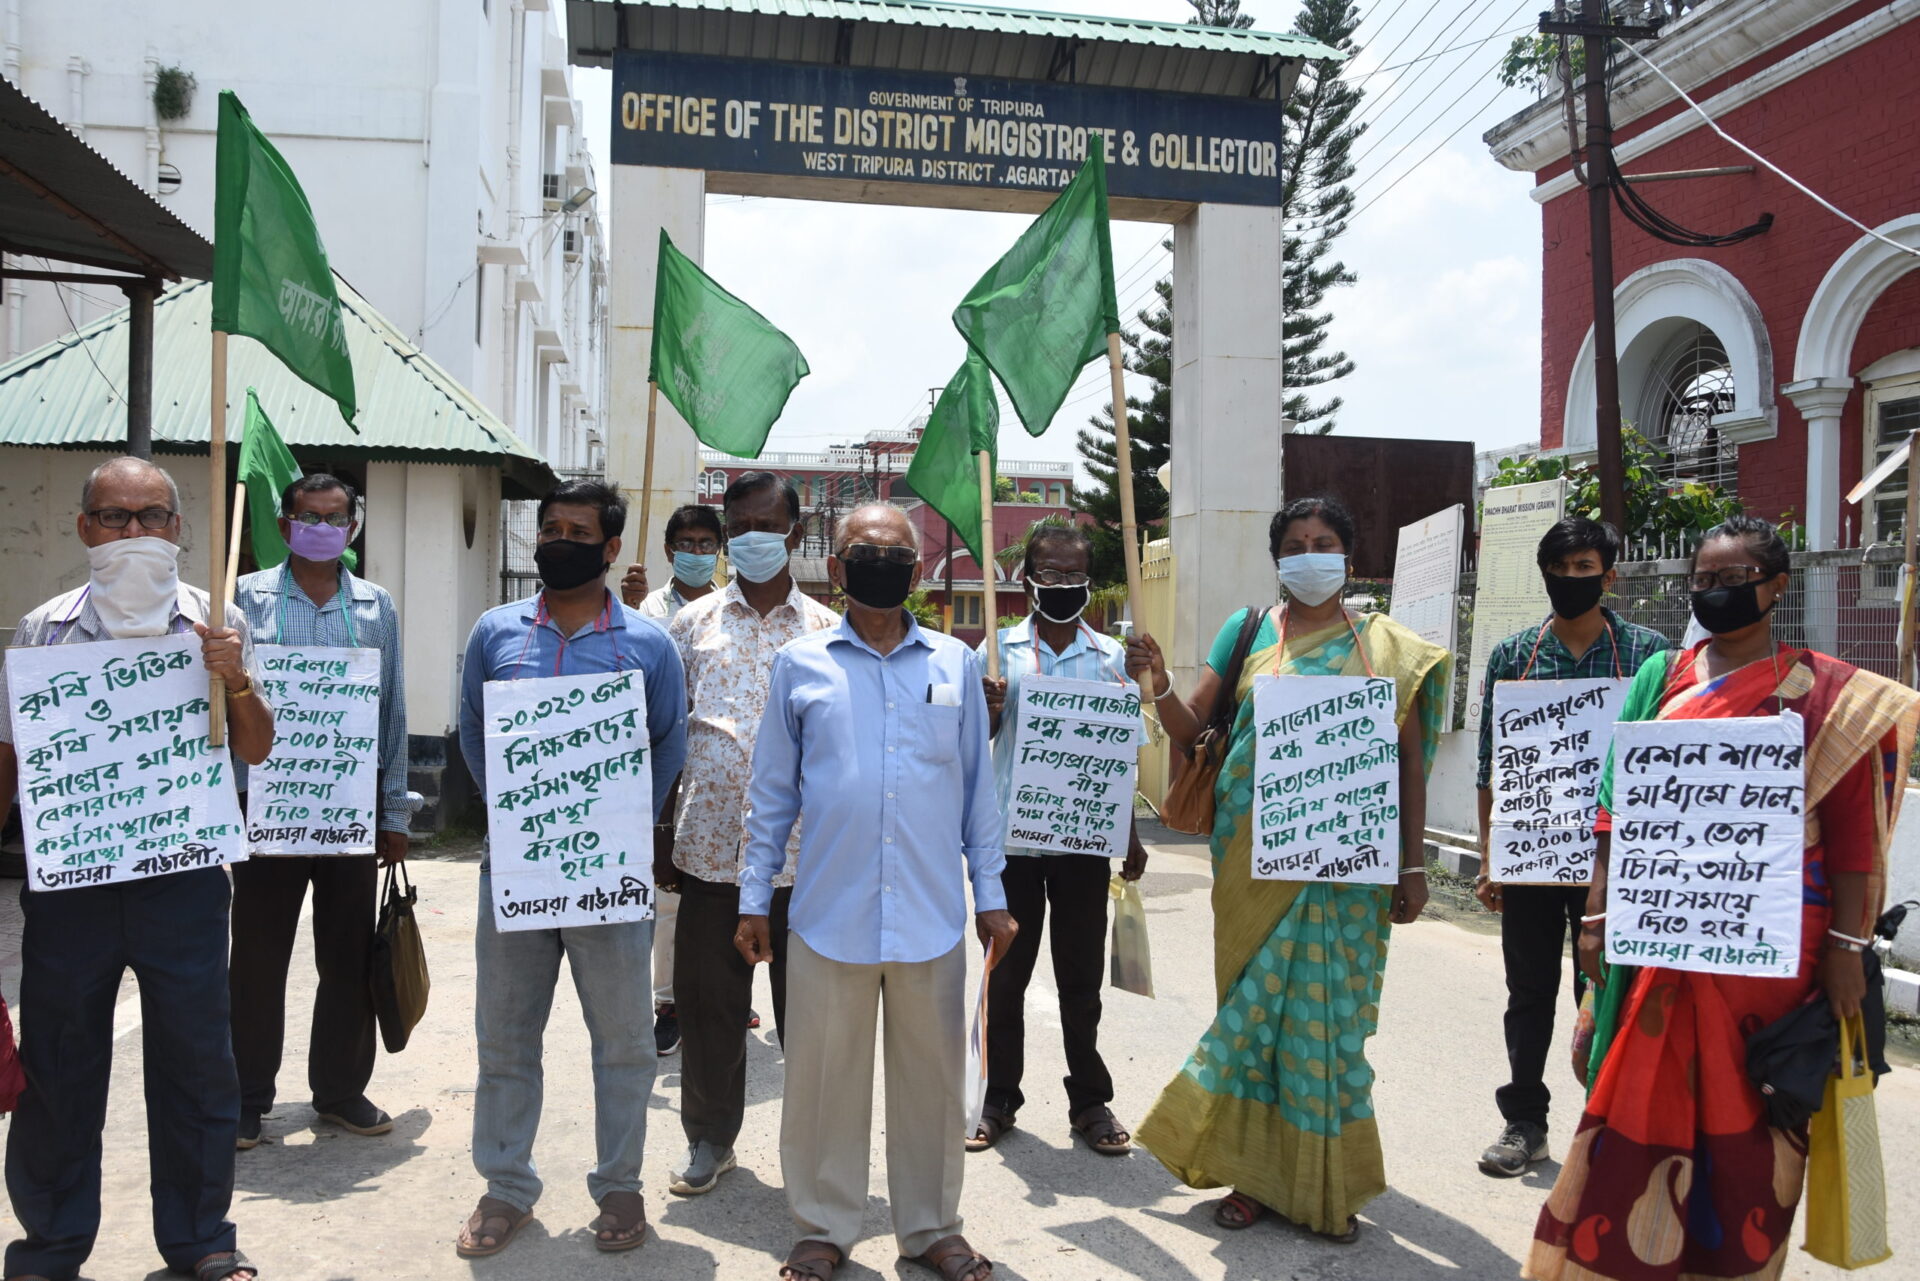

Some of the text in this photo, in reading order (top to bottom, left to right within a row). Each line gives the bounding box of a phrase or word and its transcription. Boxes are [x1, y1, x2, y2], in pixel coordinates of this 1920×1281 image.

[869, 91, 1044, 118] GOVERNMENT OF TRIPURA
[622, 91, 717, 137] OFFICE
[724, 100, 761, 139] OF
[769, 102, 823, 144] THE
[834, 106, 955, 152] DISTRICT
[1122, 130, 1140, 167] &
[1150, 132, 1277, 177] COLLECTOR
[803, 151, 847, 172] WEST
[852, 154, 915, 177] TRIPURA
[921, 158, 994, 184] DISTRICT
[19, 671, 91, 722] কৃষি
[85, 699, 112, 722] ও
[274, 702, 348, 727] তিমাসে
[1027, 715, 1135, 745] বন্ধ করতে
[25, 728, 96, 772] কৃষি
[333, 728, 376, 753] টাকা
[1269, 715, 1376, 761] বন্ধ করতে
[1498, 730, 1592, 770] বীজ সার
[1624, 742, 1803, 774] রেশন শপের
[36, 785, 148, 830] বেকারদের
[1626, 775, 1735, 813] মাধ্যমে
[265, 799, 310, 823] দিতে
[1262, 827, 1297, 850] দাম
[1360, 803, 1400, 826] দিতে
[523, 831, 600, 862] করতে
[1703, 822, 1769, 847] তেল
[1697, 851, 1769, 883] আটা
[1638, 910, 1688, 935] দিতে
